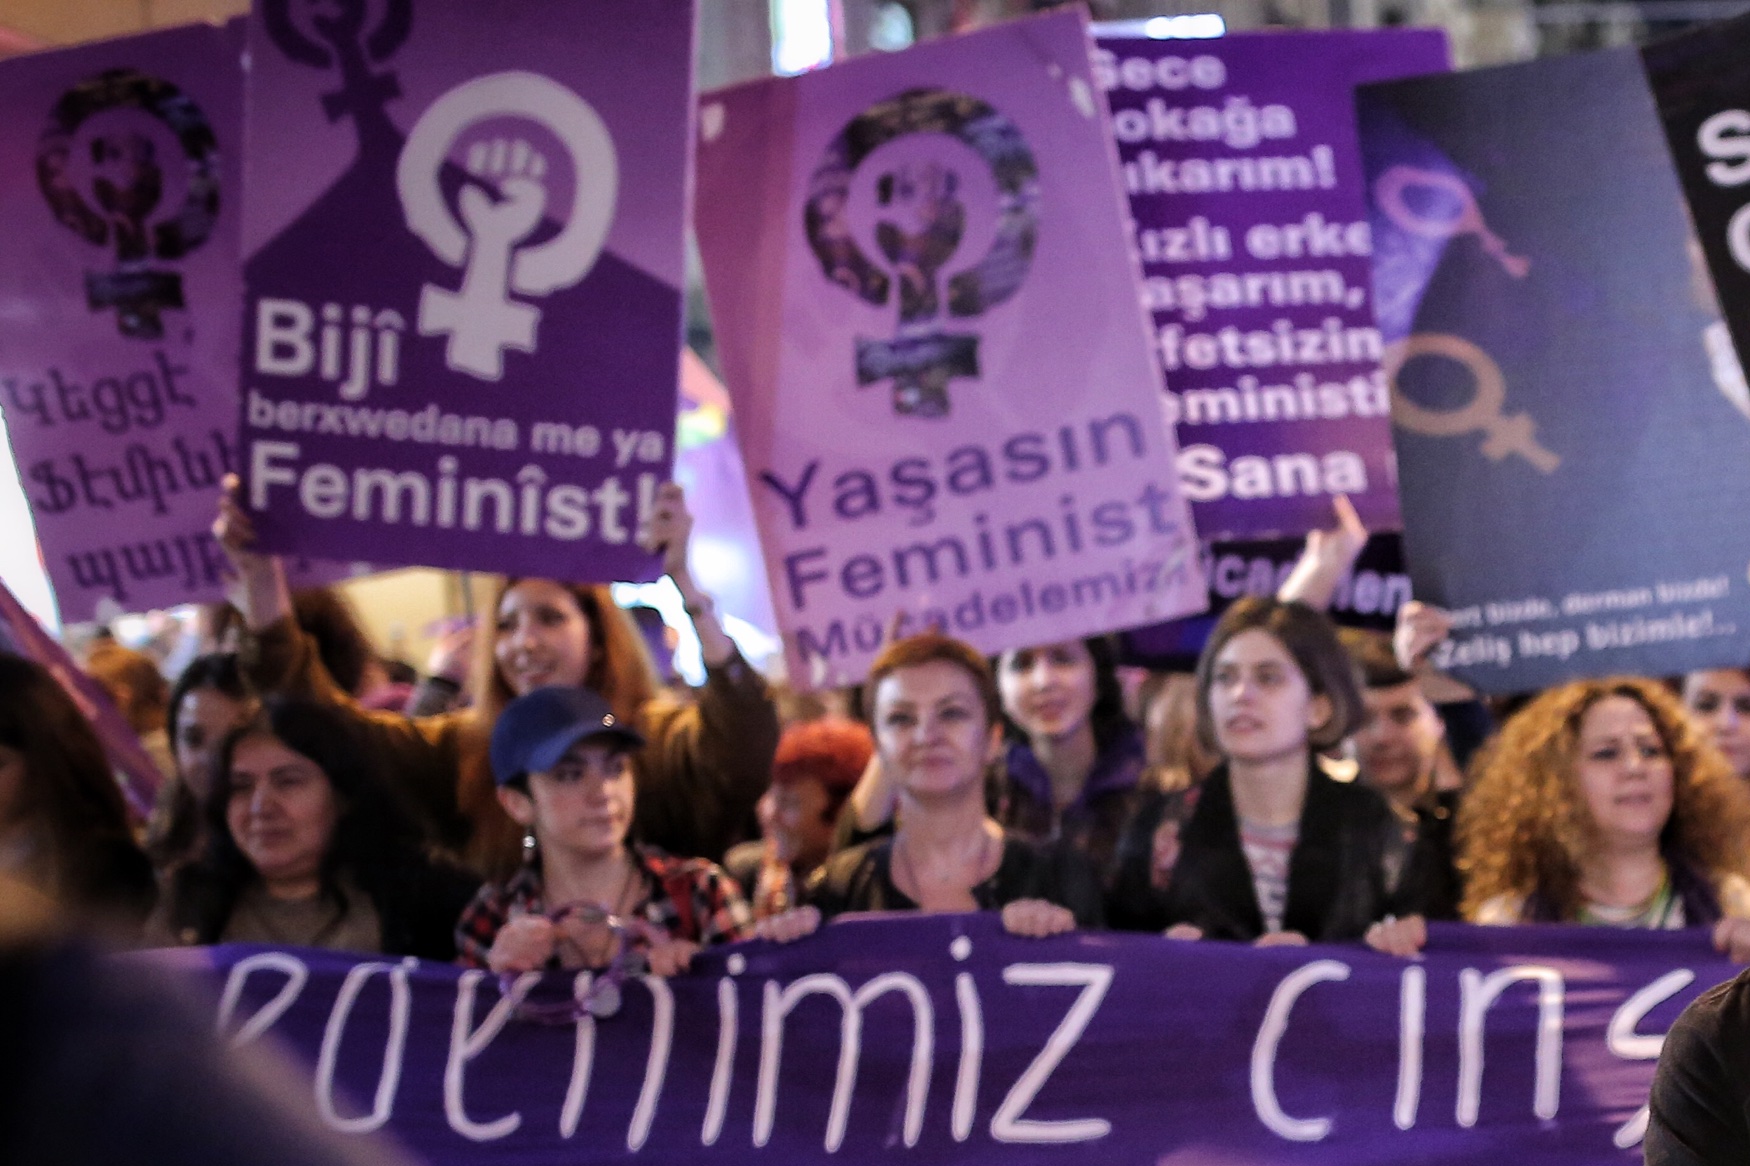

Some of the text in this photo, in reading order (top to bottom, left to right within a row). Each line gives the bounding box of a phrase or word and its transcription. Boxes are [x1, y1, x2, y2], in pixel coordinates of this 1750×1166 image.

[1113, 95, 1296, 150] okağa
[1124, 144, 1337, 195] ıkarım!
[1142, 212, 1373, 262] ızlı erke
[1144, 270, 1365, 322] aşarım,
[255, 298, 404, 400] Bijî
[247, 391, 665, 467] berxwedana me ya
[249, 440, 656, 546] Feminîst!
[759, 411, 1146, 529] Yaşasın
[1176, 444, 1368, 503] Sana
[783, 484, 1178, 611] Feminist
